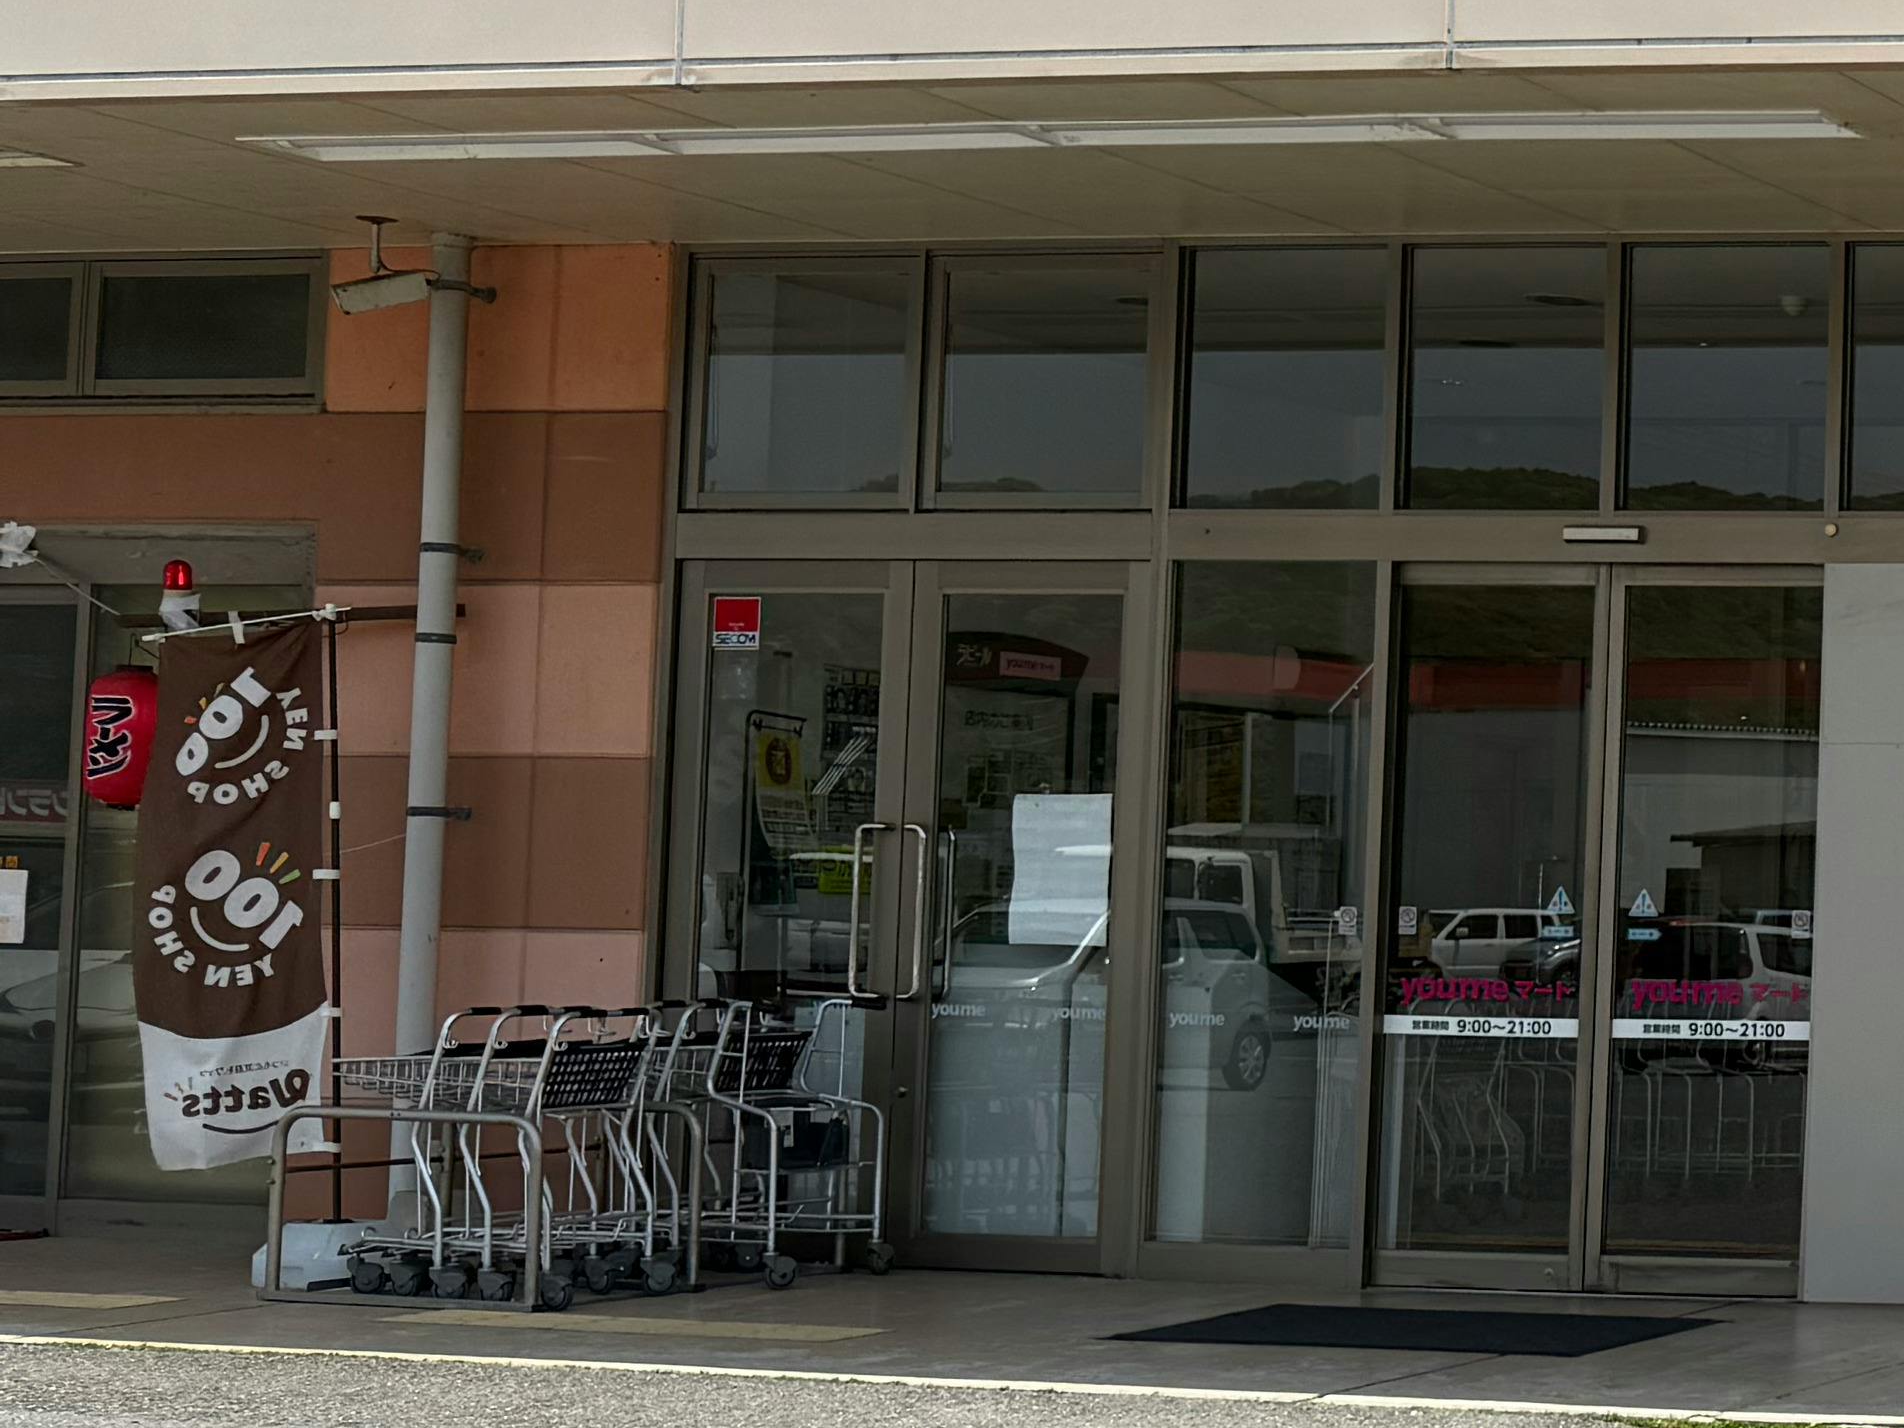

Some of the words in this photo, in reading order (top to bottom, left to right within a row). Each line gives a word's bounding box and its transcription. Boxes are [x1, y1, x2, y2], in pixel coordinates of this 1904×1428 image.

[715, 633, 757, 645] SECOM
[86, 695, 135, 779] ラーメン
[1400, 977, 1509, 1007] youme
[1514, 979, 1576, 1002] マート
[1632, 980, 1745, 1011] youme
[931, 1001, 987, 1019] youme
[1169, 1011, 1225, 1029] youme
[1293, 1014, 1350, 1031] youme
